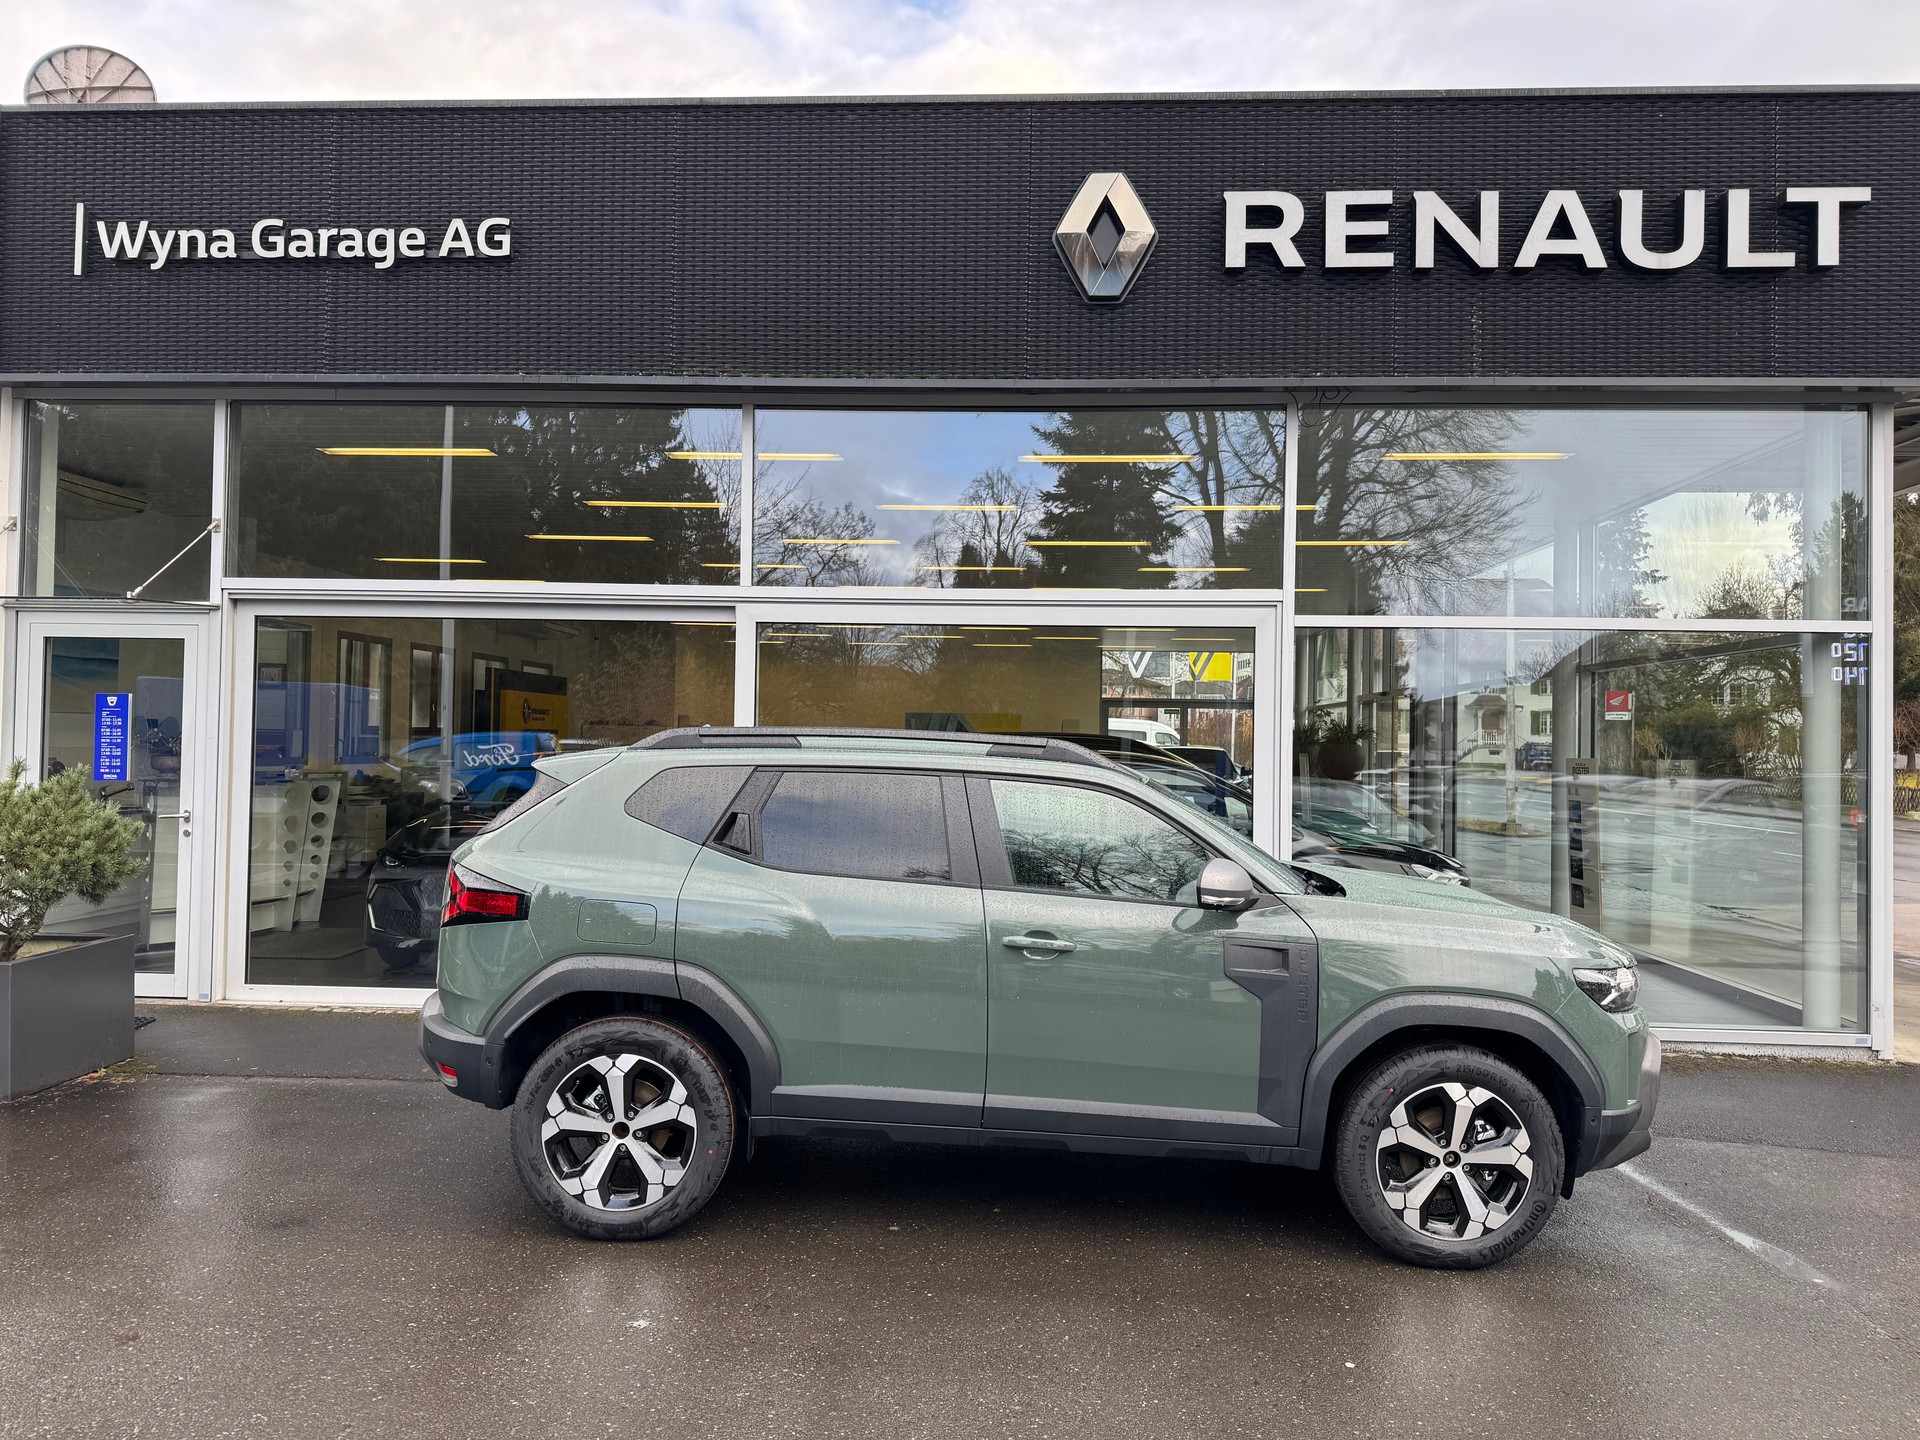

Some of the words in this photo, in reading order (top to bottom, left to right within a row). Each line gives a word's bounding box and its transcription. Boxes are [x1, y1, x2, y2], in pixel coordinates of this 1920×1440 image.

[96, 220, 237, 270] Wyna
[251, 218, 427, 270] Garage
[438, 217, 512, 258] AG
[1224, 187, 1872, 270] RENAULT
